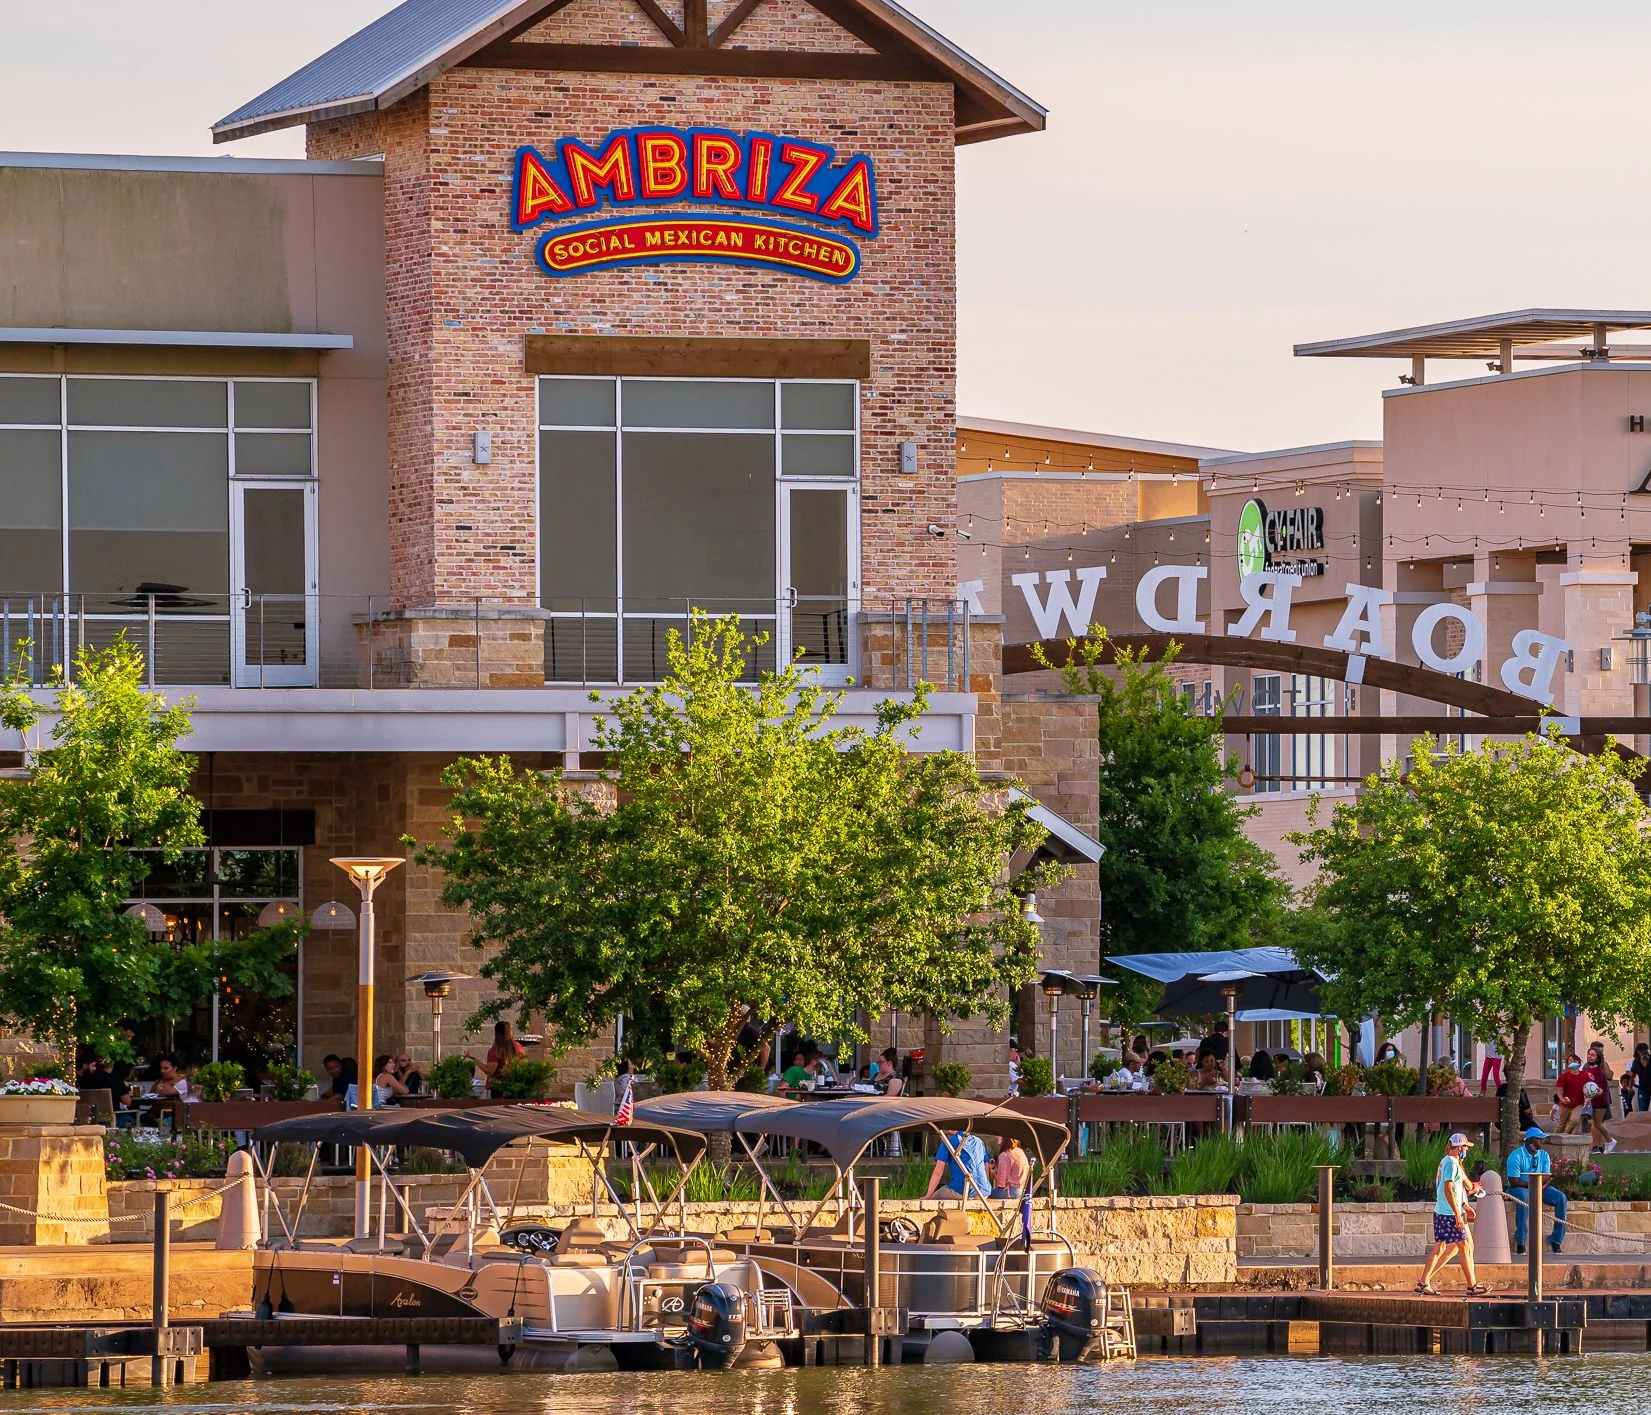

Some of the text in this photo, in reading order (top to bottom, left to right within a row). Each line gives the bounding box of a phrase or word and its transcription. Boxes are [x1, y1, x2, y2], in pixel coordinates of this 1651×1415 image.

[518, 132, 874, 233] AMBRIZA
[554, 230, 846, 266] SOCIAL MEXICAN KITCHEN
[1301, 559, 1318, 577] union
[390, 1292, 421, 1308] Avalon
